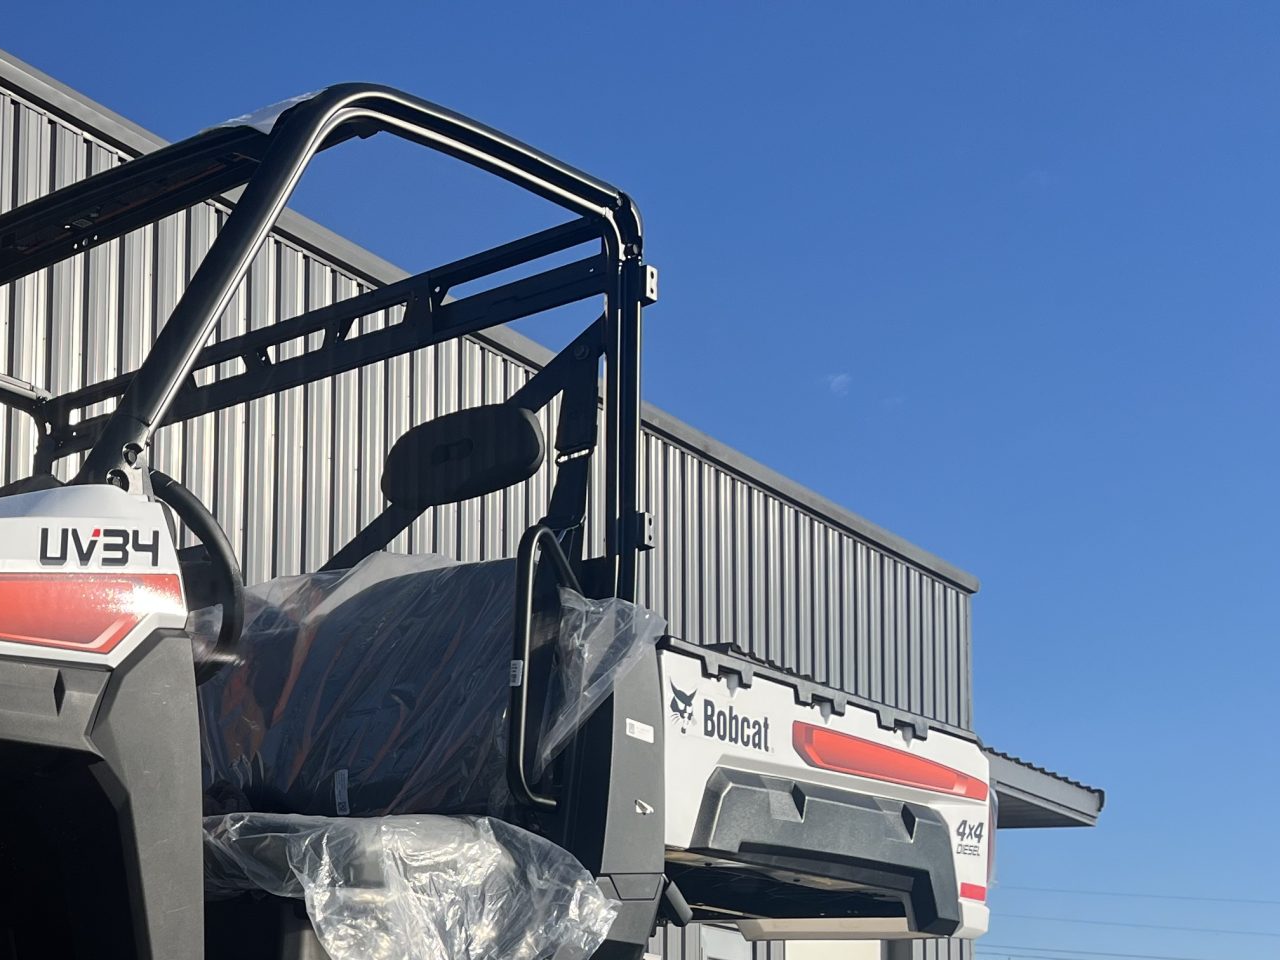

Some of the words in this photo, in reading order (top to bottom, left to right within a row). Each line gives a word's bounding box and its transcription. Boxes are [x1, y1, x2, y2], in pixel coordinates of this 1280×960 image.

[39, 527, 160, 568] UV34
[703, 698, 769, 752] Bobcat
[956, 819, 985, 844] 4x4
[956, 843, 981, 857] DIESEL
